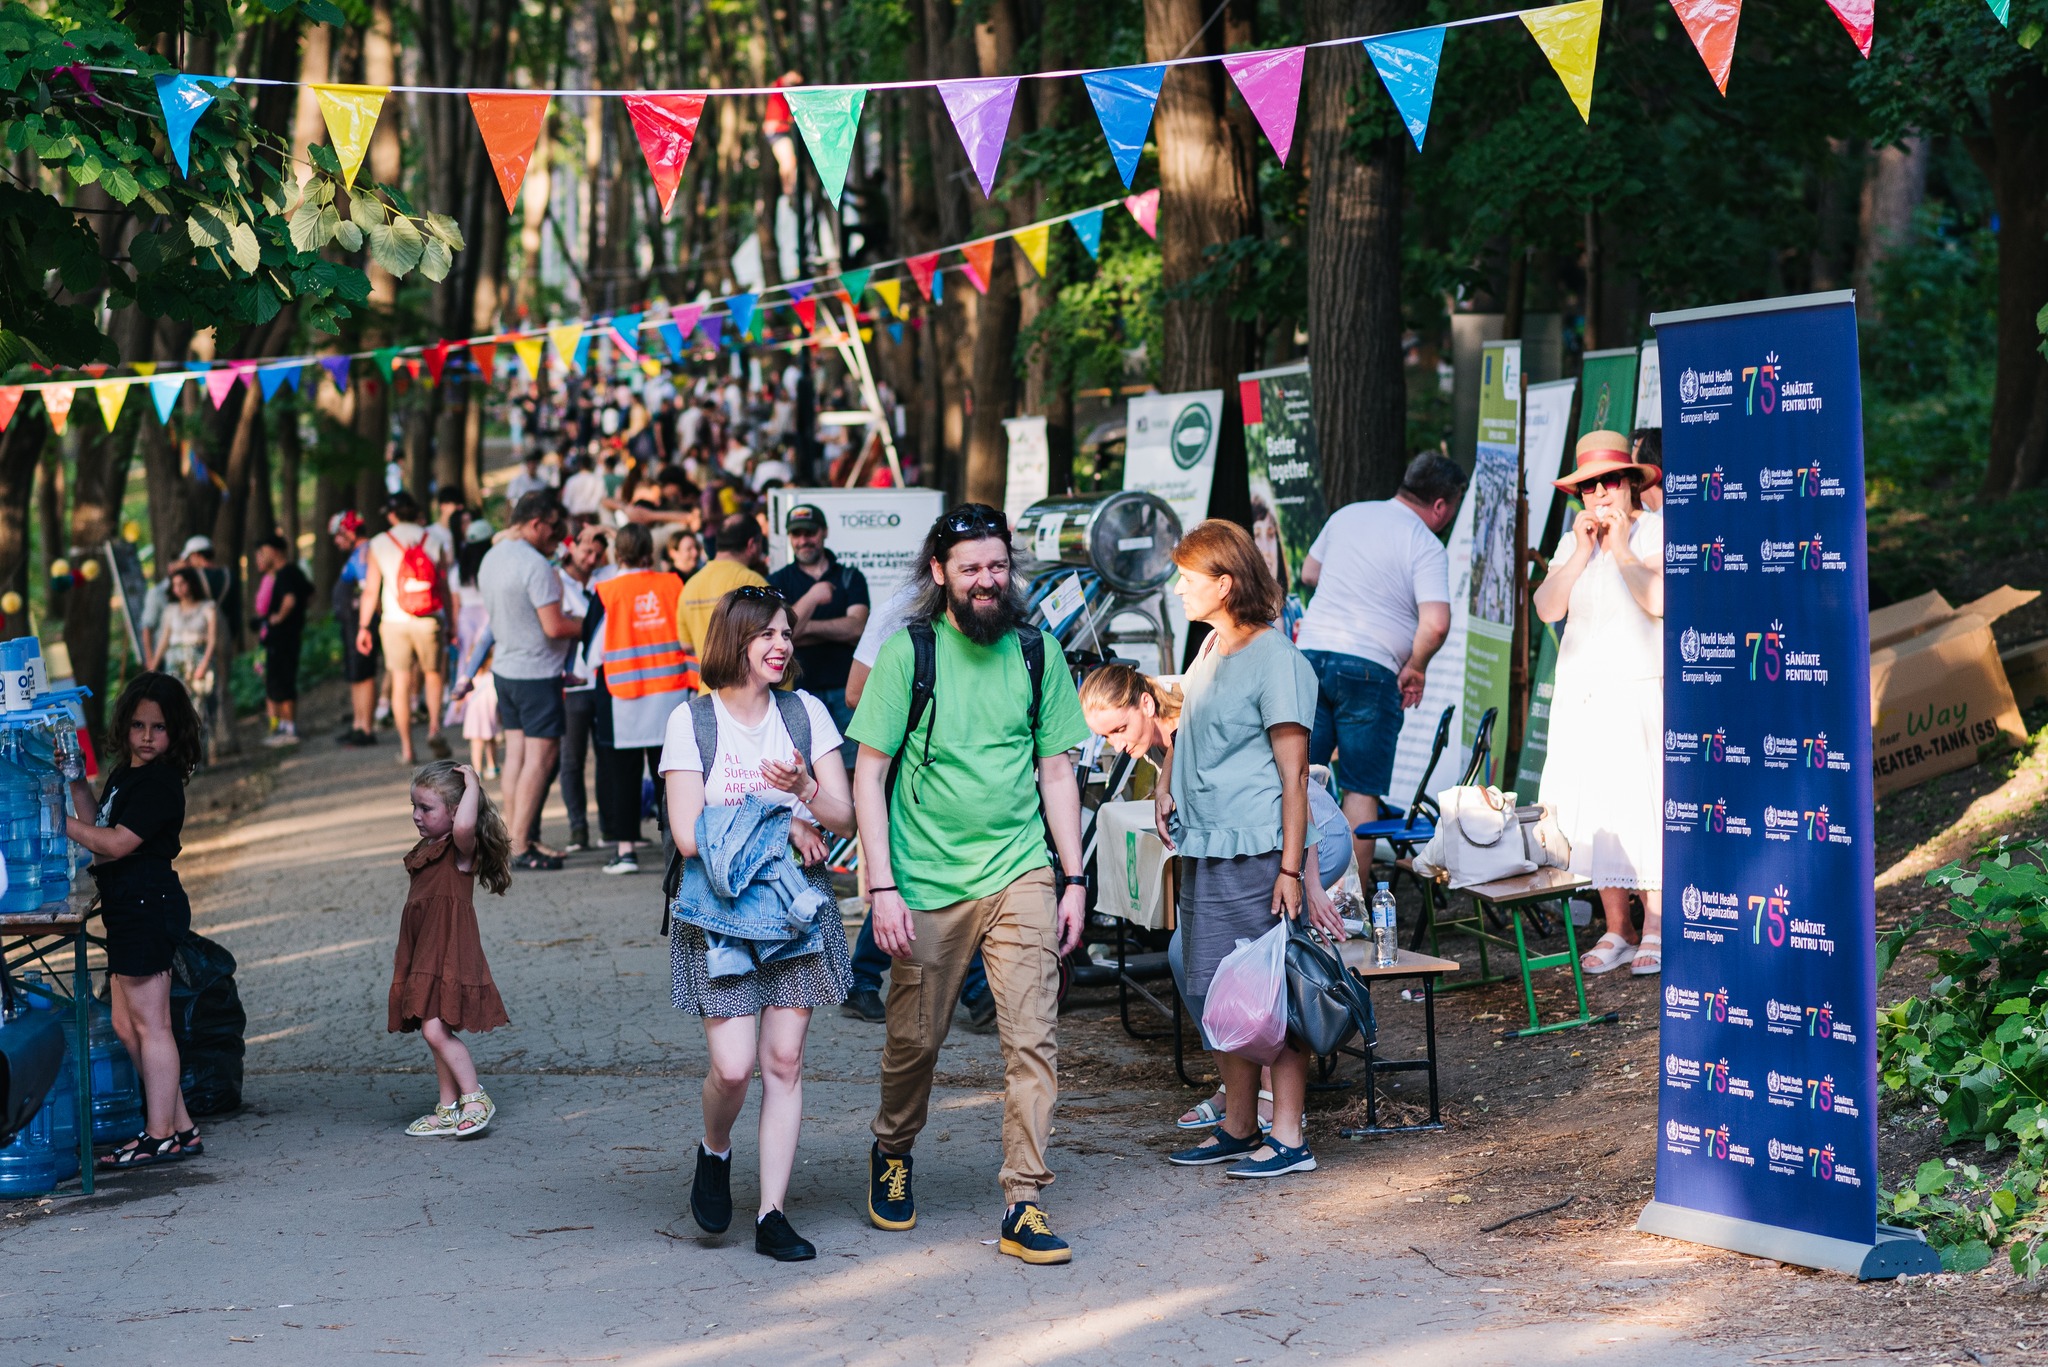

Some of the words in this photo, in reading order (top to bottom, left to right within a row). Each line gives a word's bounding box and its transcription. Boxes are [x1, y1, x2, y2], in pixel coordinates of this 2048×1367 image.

[1699, 371, 1714, 385] World
[1716, 369, 1733, 383] Health
[1699, 383, 1733, 400] Organization
[1743, 365, 1776, 416] 75
[1781, 381, 1814, 397] SĂNĂTATE
[1781, 399, 1807, 412] PENTRU
[1808, 397, 1822, 414] TOȚI
[1682, 412, 1702, 425] European
[1703, 411, 1719, 424] Region
[1266, 436, 1296, 457] Better
[1268, 458, 1309, 485] together
[1772, 470, 1781, 478] World
[1782, 469, 1792, 477] Health
[1676, 475, 1685, 483] World
[1686, 474, 1696, 482] Health
[1772, 477, 1792, 487] Organization
[1798, 468, 1818, 498] 75
[1676, 482, 1696, 491] Organization
[1702, 472, 1721, 501] 75
[1820, 488, 1836, 496] PENTRU
[1679, 497, 1689, 505] Region
[1723, 492, 1738, 500] PENTRU
[840, 514, 901, 527] TORECO
[1687, 544, 1697, 552] Health
[1773, 542, 1782, 550] World
[1783, 542, 1794, 550] Health
[1677, 552, 1697, 561] Organization
[1702, 543, 1722, 572] 75
[1773, 550, 1794, 559] Organization
[1800, 541, 1820, 570] 75
[1667, 567, 1679, 575] European
[1679, 567, 1689, 575] Region
[1762, 566, 1775, 574] European
[1775, 566, 1785, 574] Region
[1701, 633, 1716, 645] World
[1718, 633, 1735, 645] Health
[1701, 646, 1735, 661] Organization
[1746, 633, 1780, 681] 75
[1785, 651, 1820, 666] SĂNĂTATE
[1683, 671, 1704, 684] European
[1705, 672, 1722, 685] Region
[1786, 669, 1812, 681] PENTRU
[1813, 670, 1828, 686] TOȚI
[1907, 702, 1968, 737] Way
[1677, 733, 1687, 741] World
[1687, 733, 1698, 741] Health
[1776, 737, 1786, 746] World
[1787, 738, 1798, 746] Health
[1677, 741, 1698, 749] Organization
[1703, 734, 1723, 762] 75
[1776, 746, 1798, 755] Organization
[724, 753, 741, 765] ALL
[1667, 755, 1680, 763] European
[1680, 755, 1690, 763] Region
[1726, 755, 1741, 763] PENTRU
[1804, 739, 1824, 768] 75
[1826, 761, 1842, 769] PENTRU
[725, 783, 745, 793] ARE
[1677, 802, 1687, 810] World
[1687, 803, 1698, 811] Health
[1677, 810, 1698, 819] Organization
[1704, 804, 1724, 833] 75
[1777, 809, 1787, 818] World
[1788, 810, 1799, 819] Health
[1777, 818, 1799, 827] Organization
[1805, 811, 1826, 841] 75
[1667, 824, 1679, 832] European
[1680, 825, 1690, 833] Region
[1726, 826, 1742, 834] PENTRU
[1702, 891, 1718, 905] World
[1720, 893, 1738, 907] Health
[1702, 905, 1738, 920] Organization
[1749, 895, 1785, 947] 75
[1790, 918, 1826, 936] SĂNĂTATE
[1684, 928, 1706, 942] European
[1707, 930, 1724, 944] Region
[1790, 936, 1818, 950] PENTRU
[1818, 939, 1834, 957] TOȚI
[1678, 989, 1688, 997] World
[1688, 990, 1699, 999] Health
[1678, 997, 1699, 1006] Organization
[1705, 992, 1725, 1022] 75
[1779, 1003, 1790, 1012] World
[1790, 1004, 1802, 1014] Health
[1728, 1016, 1744, 1025] PENTRU
[1779, 1011, 1802, 1022] Organization
[1808, 1007, 1830, 1038] 75
[1831, 1032, 1848, 1041] PENTRU
[1678, 1058, 1688, 1067] World
[1689, 1060, 1700, 1069] Health
[1678, 1066, 1700, 1076] Organization
[1705, 1062, 1726, 1093] 75
[1780, 1075, 1790, 1084] World
[1791, 1077, 1803, 1086] Health
[1729, 1087, 1744, 1096] PENTRU
[1780, 1083, 1803, 1094] Organization
[1809, 1079, 1831, 1111] 75
[1833, 1105, 1849, 1114] PENTRU
[1679, 1124, 1688, 1133] World
[1689, 1126, 1700, 1135] Health
[1679, 1132, 1700, 1142] Organization
[1706, 1129, 1726, 1159] 75
[1781, 1143, 1791, 1152] World
[1792, 1145, 1803, 1154] Health
[1729, 1153, 1745, 1163] PENTRU
[1781, 1151, 1803, 1162] Organization
[1810, 1148, 1832, 1180] 75
[1834, 1174, 1851, 1184] PENTRU
